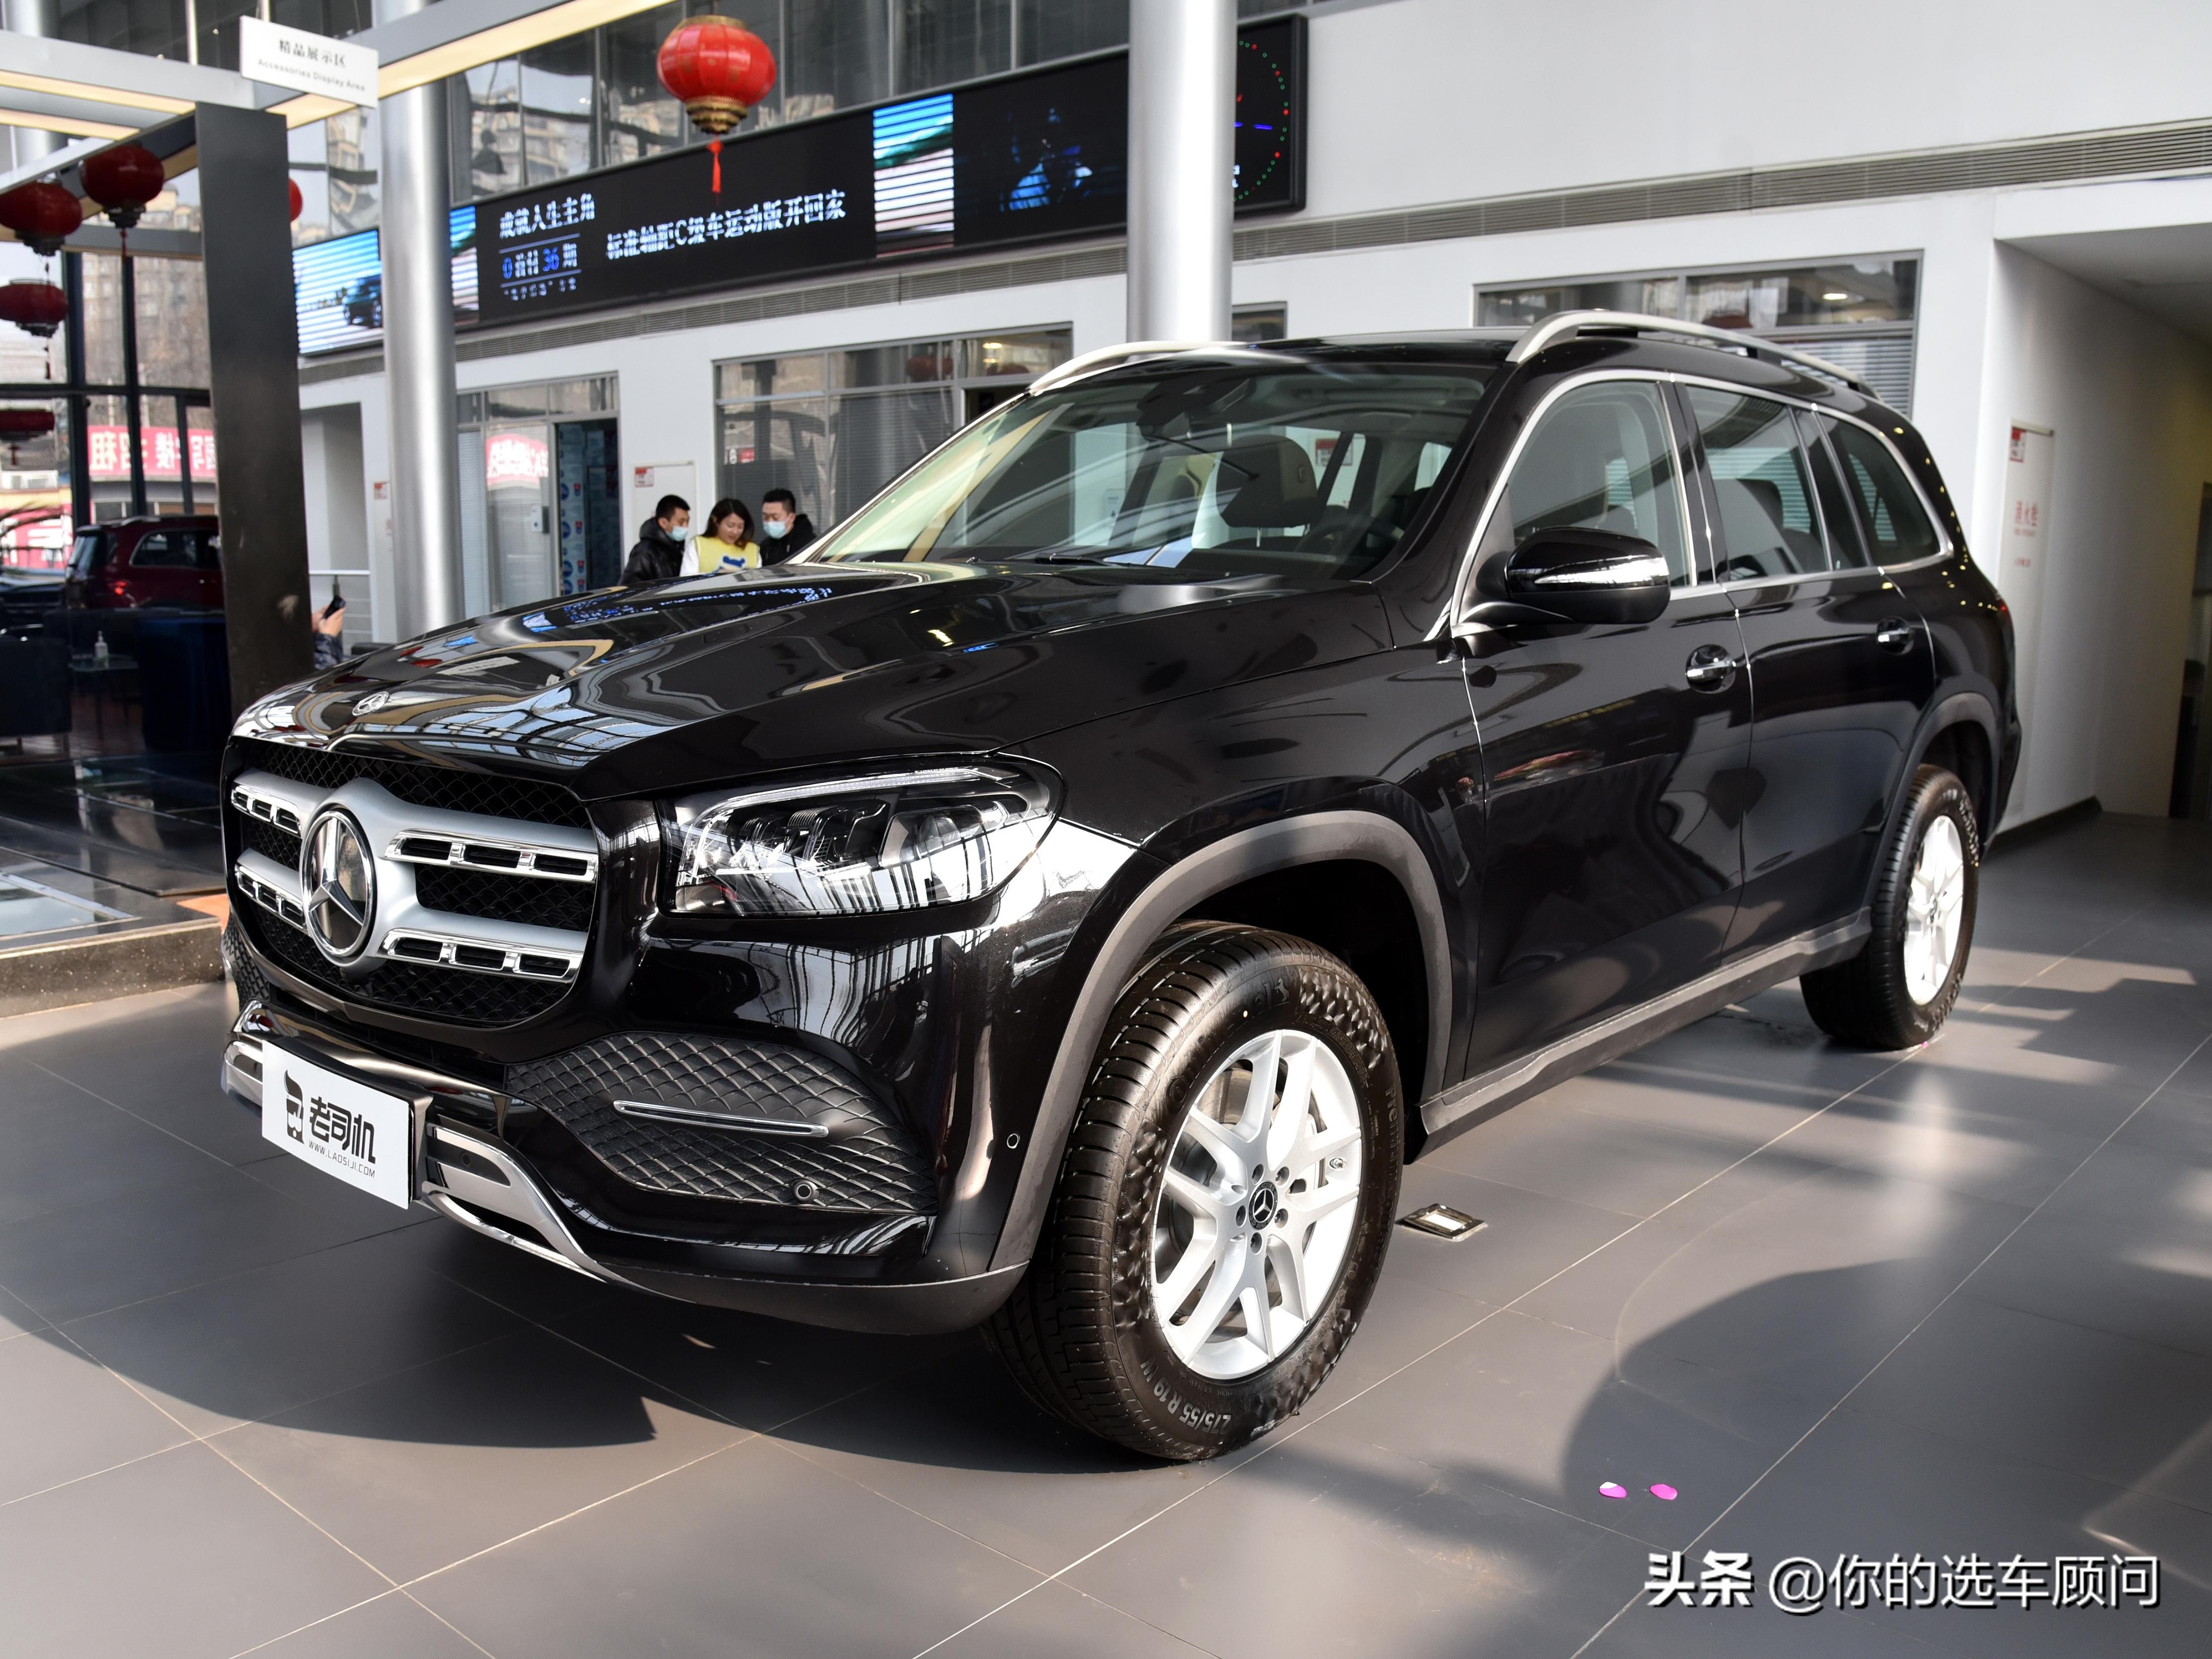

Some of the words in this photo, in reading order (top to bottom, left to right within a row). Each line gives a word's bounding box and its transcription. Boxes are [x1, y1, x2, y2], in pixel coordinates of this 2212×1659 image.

[279, 39, 346, 68] 精品展示区
[258, 58, 311, 78] Accessories
[312, 71, 344, 88] Display
[346, 79, 366, 91] Area
[309, 1096, 376, 1164] 老司机
[308, 1139, 375, 1178] WWW.LAOSIJI.COM
[1154, 1376, 1172, 1402] 19
[1167, 1391, 1182, 1414] R
[1179, 1402, 1232, 1435] 275/55
